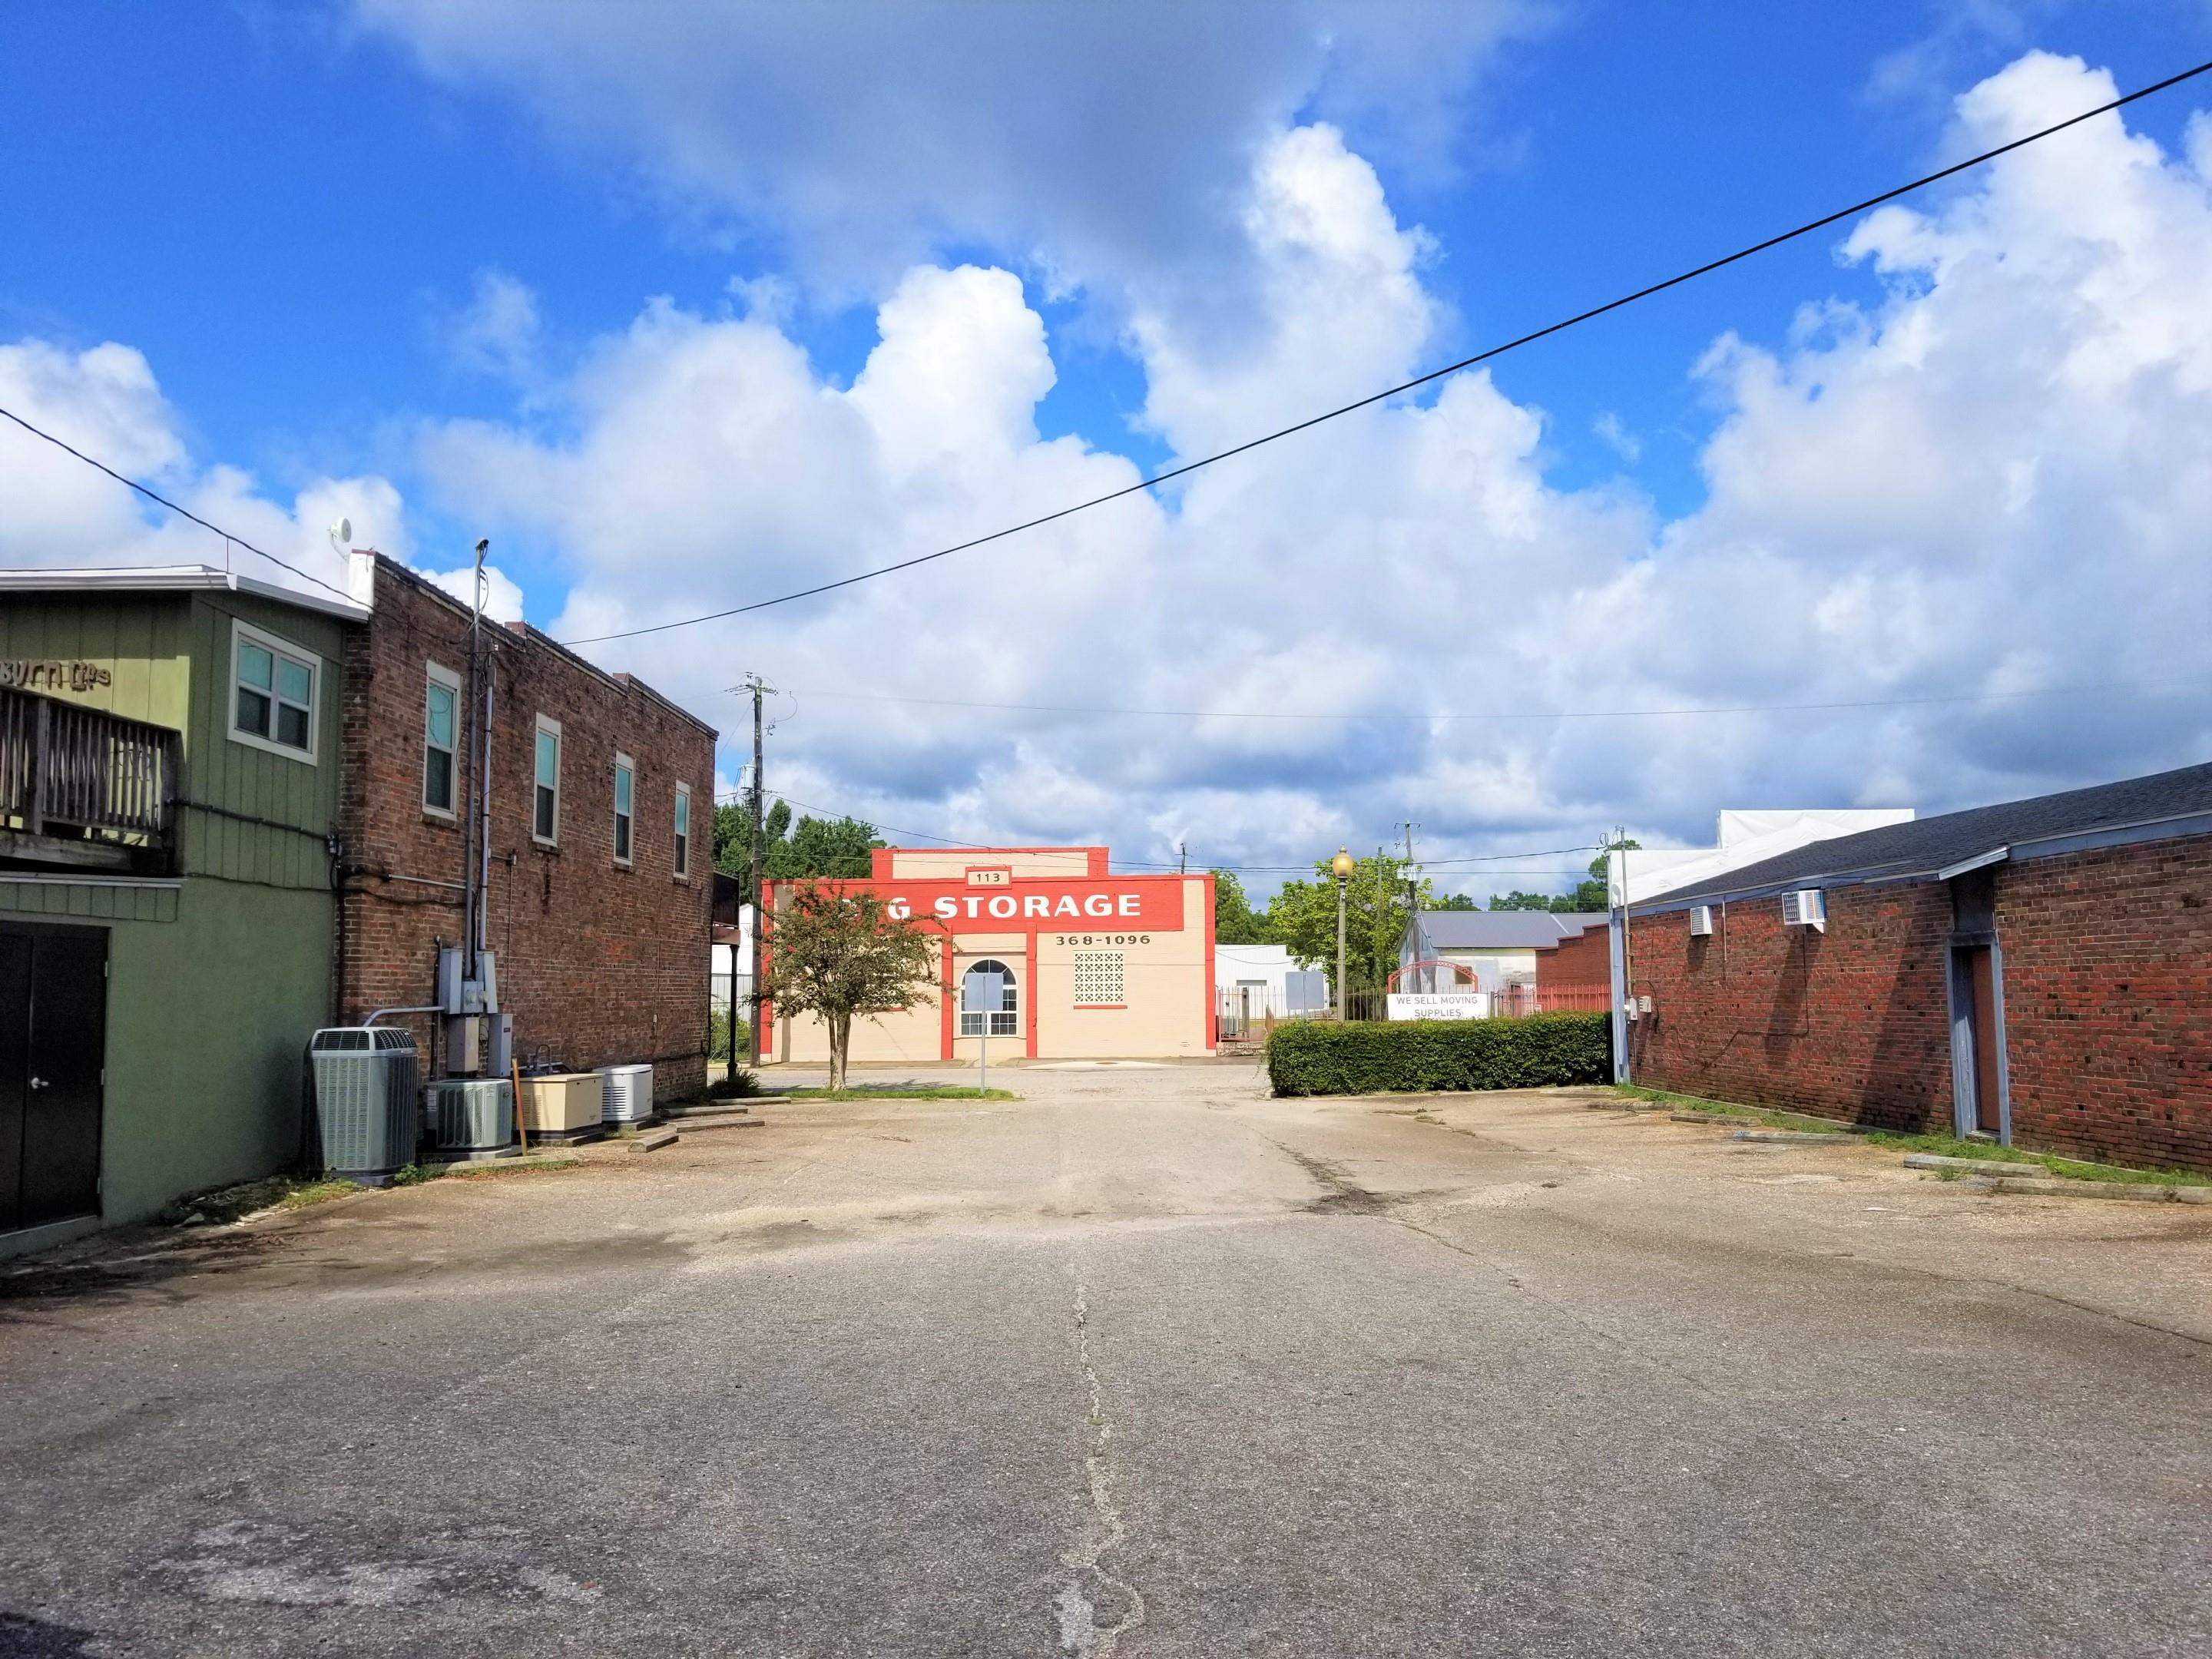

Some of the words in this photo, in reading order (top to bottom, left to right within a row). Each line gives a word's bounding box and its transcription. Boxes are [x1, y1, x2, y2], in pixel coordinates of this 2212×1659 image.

[976, 873, 1000, 882] 113
[934, 894, 1141, 919] STORAGE
[1056, 935, 1151, 945] 368-1096
[1396, 996, 1411, 1005] WE
[1414, 996, 1438, 1005] SELL
[1440, 996, 1478, 1005] MOVING
[1414, 1008, 1462, 1017] SUPPLIES
